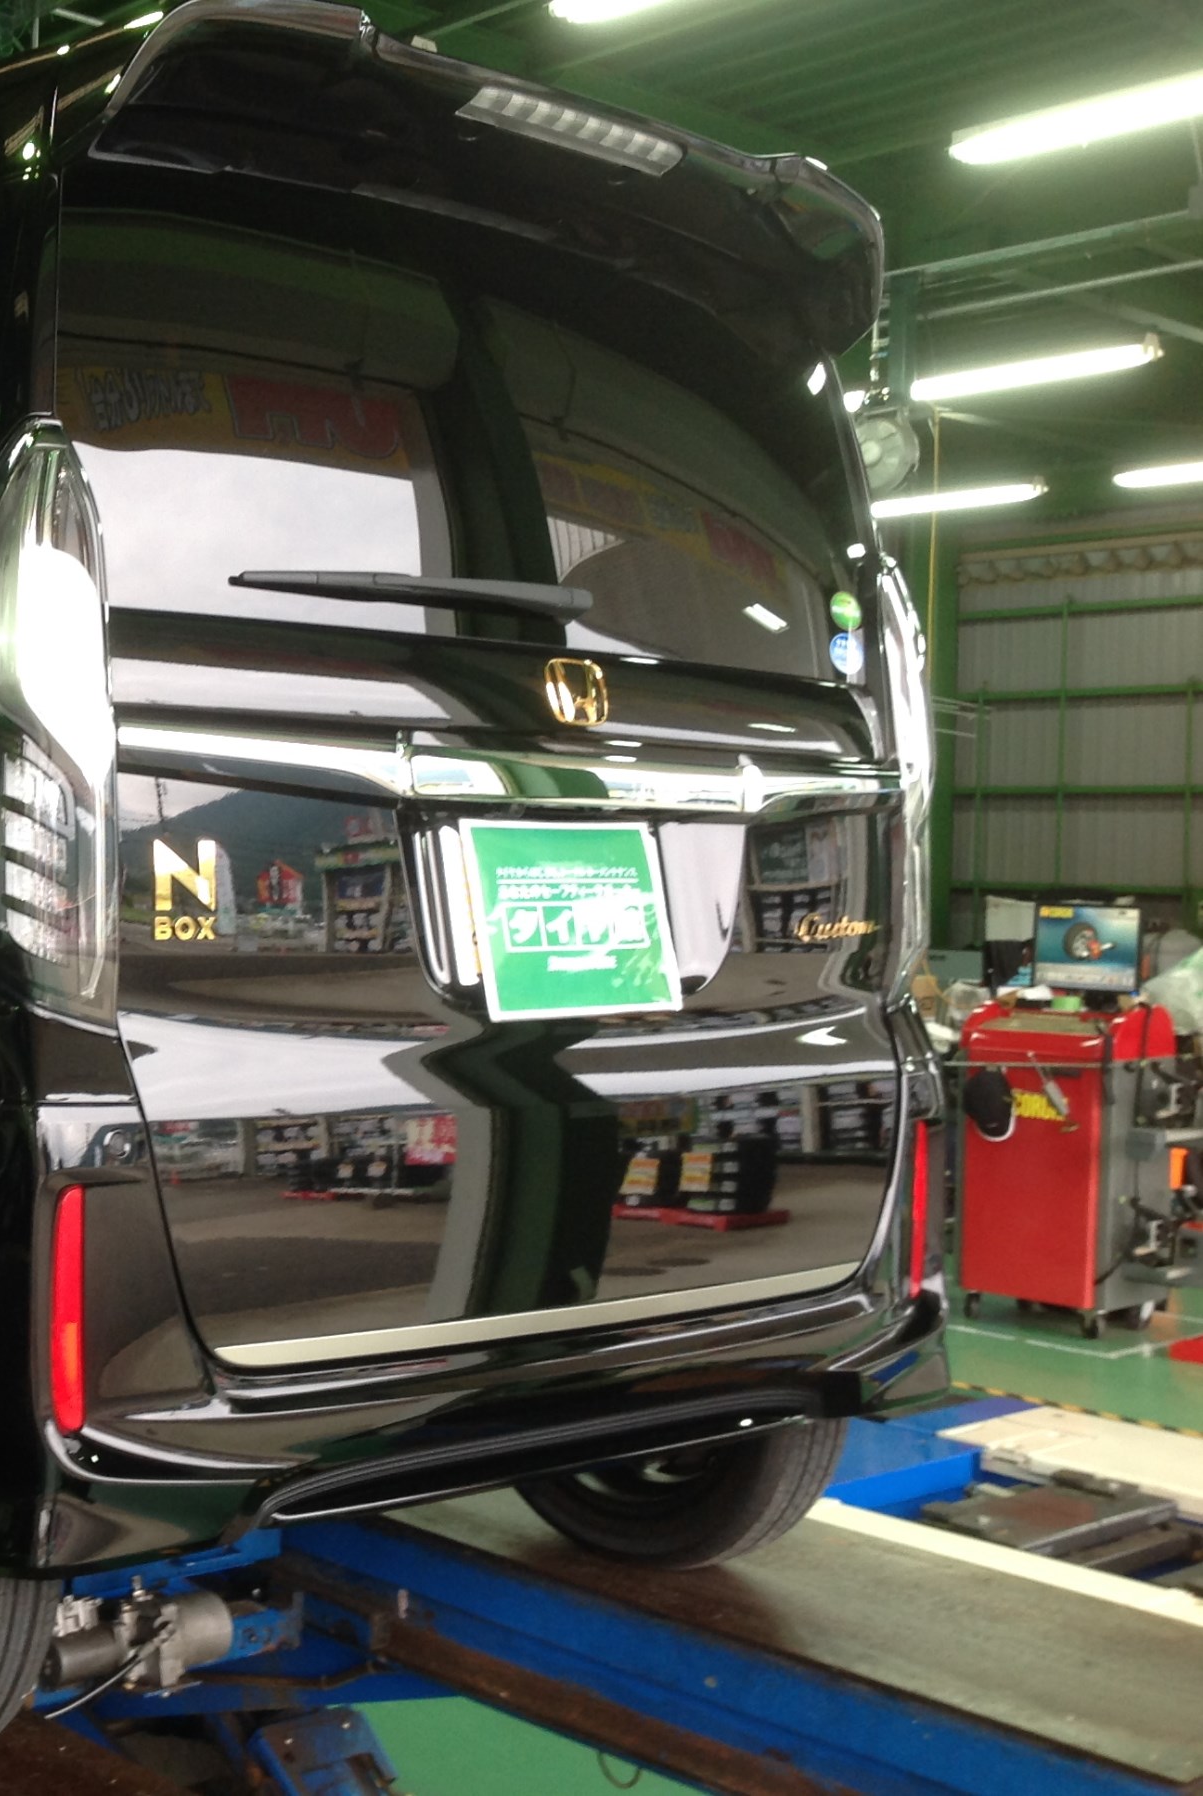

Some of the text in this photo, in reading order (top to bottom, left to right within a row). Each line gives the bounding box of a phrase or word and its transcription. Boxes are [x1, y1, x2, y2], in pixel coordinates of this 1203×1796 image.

[153, 838, 216, 912] N
[154, 915, 217, 941] BOX
[794, 911, 882, 943] Custom
